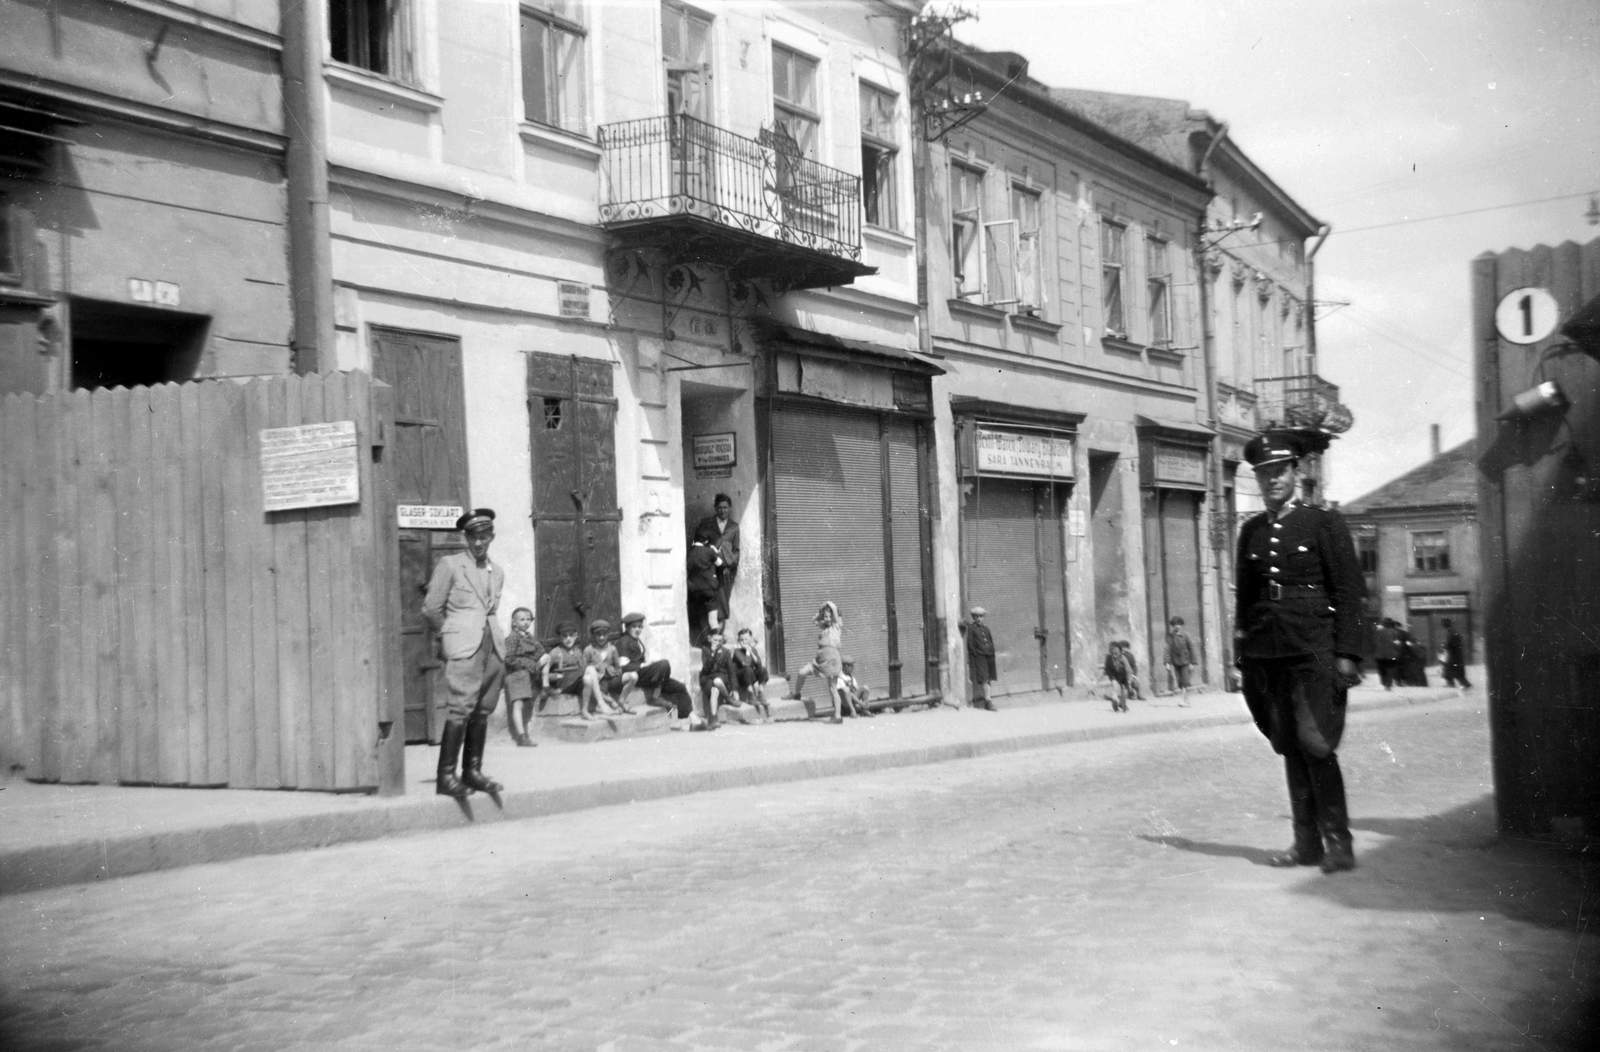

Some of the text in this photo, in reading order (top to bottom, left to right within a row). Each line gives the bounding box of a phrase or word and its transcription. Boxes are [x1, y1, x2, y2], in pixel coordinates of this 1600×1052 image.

[1519, 294, 1532, 336] 1
[988, 454, 1063, 470] SARA TANNENBAUM
